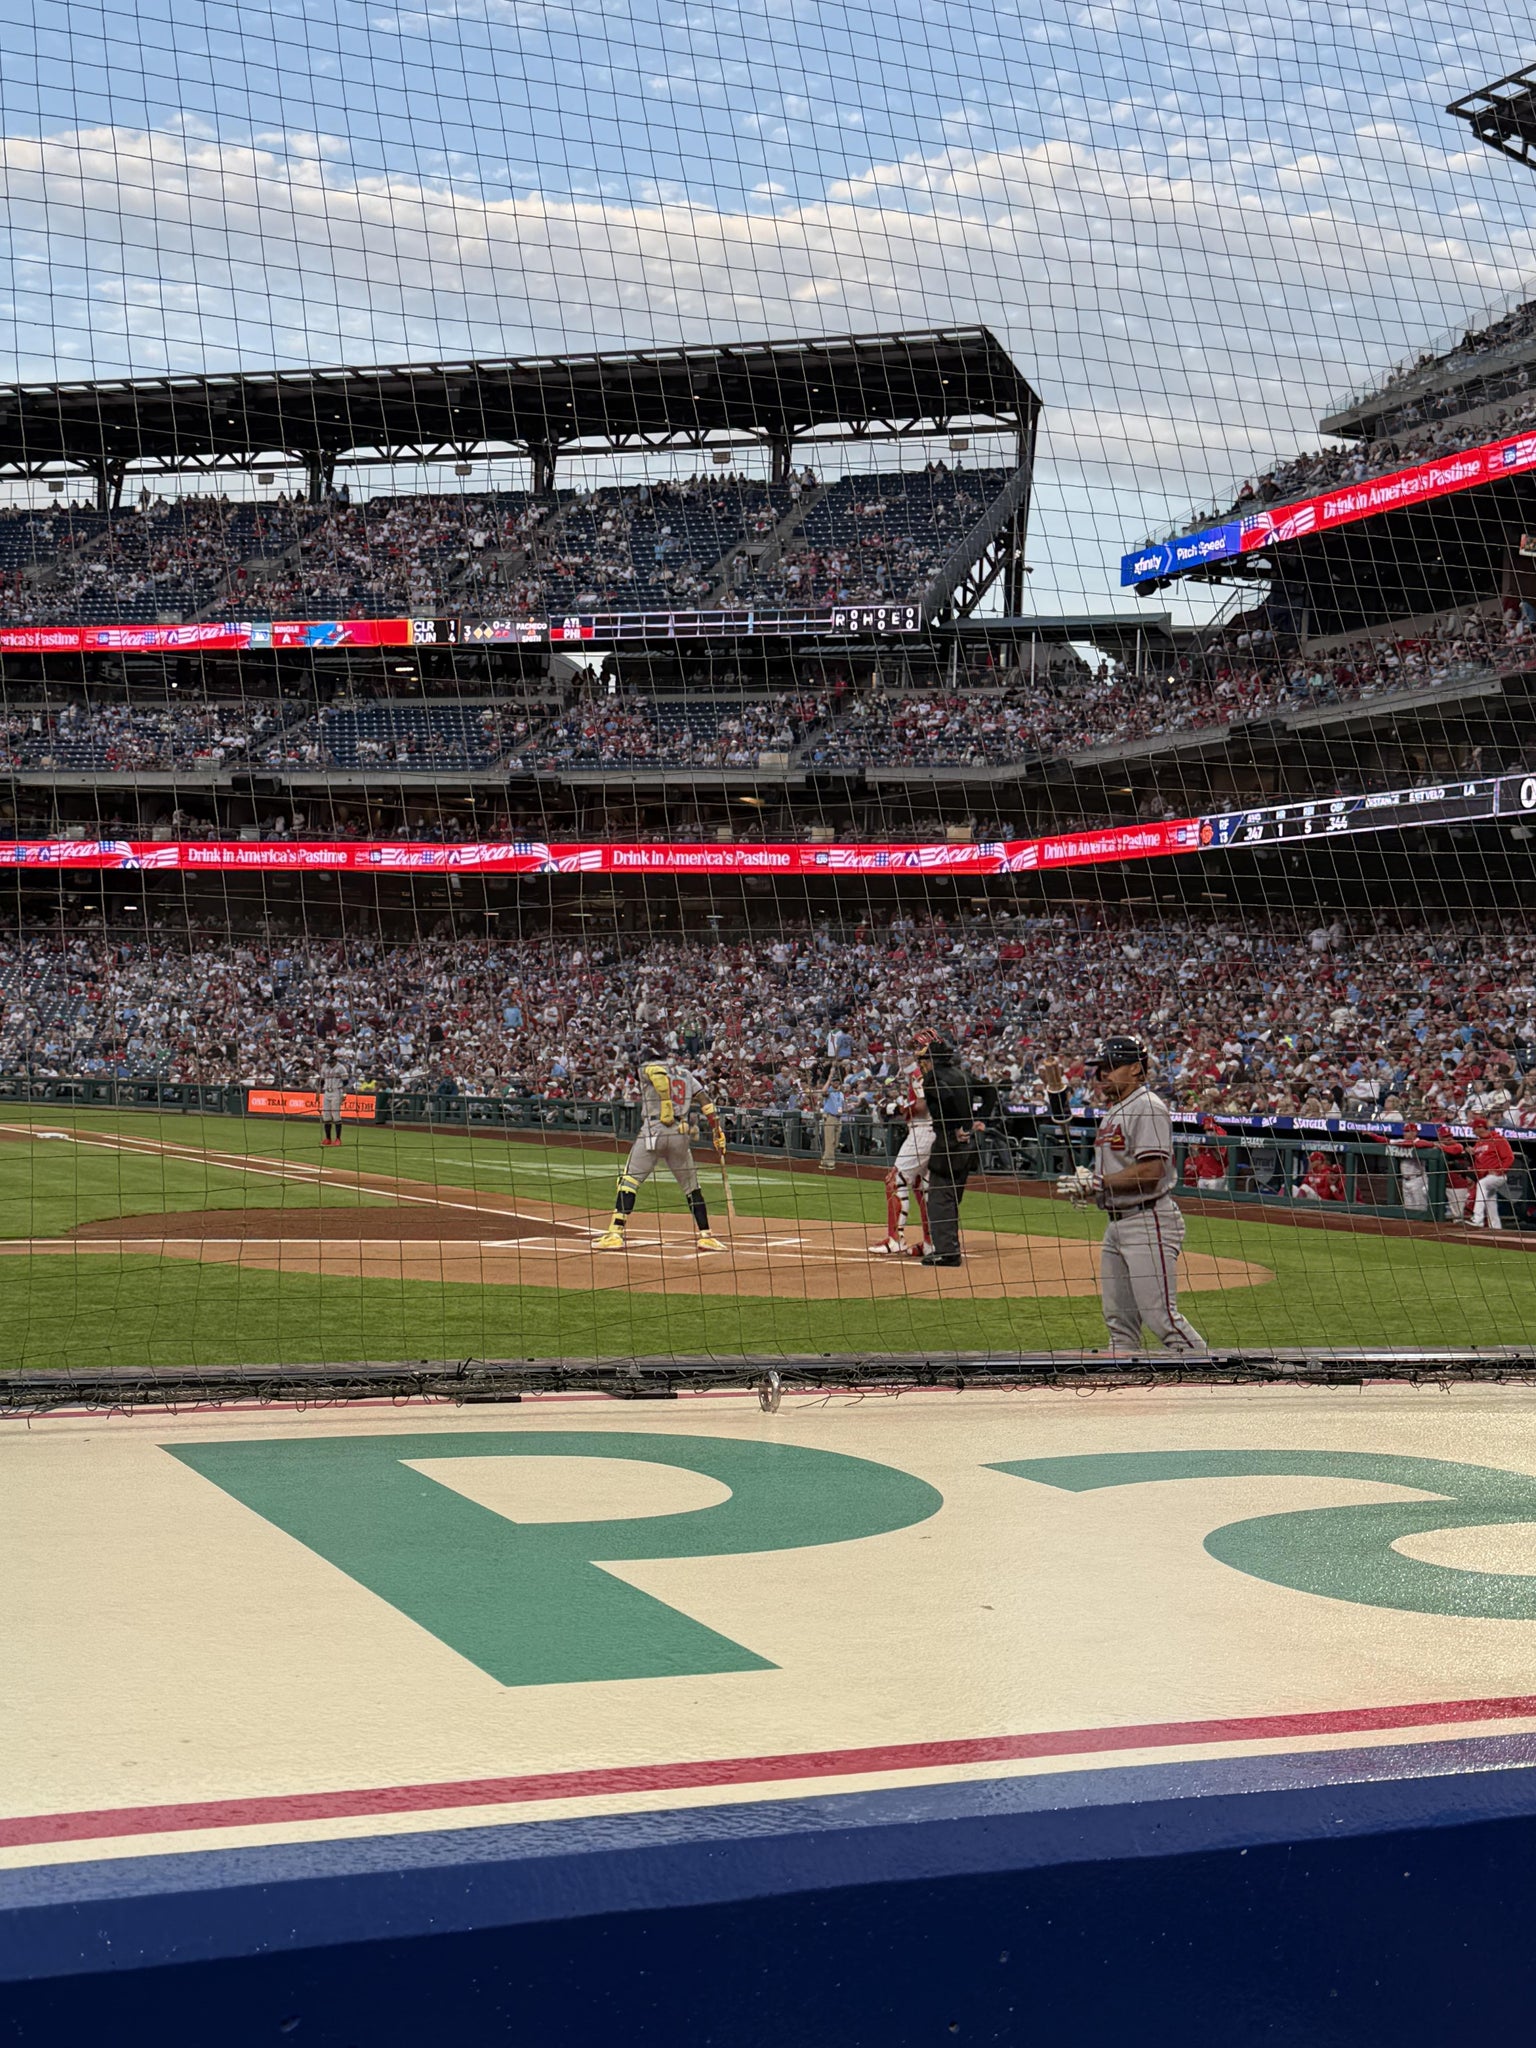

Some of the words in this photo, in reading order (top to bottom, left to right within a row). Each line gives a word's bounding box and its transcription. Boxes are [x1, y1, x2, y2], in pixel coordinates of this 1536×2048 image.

[1324, 497, 1355, 519] Drink
[1356, 493, 1367, 508] in
[1369, 478, 1428, 507] America's
[1430, 460, 1480, 487] Pastime
[1177, 546, 1197, 560] Pitch
[1199, 536, 1226, 556] Speed
[1134, 555, 1162, 575] xfinity
[835, 614, 845, 626] R
[863, 613, 873, 626] H
[891, 612, 900, 625] E
[850, 610, 858, 619] 0
[877, 609, 886, 619] 0
[906, 608, 914, 618] 0
[413, 621, 434, 632] CLR
[449, 621, 455, 630] 1
[492, 621, 511, 629] 0-2
[563, 618, 582, 628] ATL
[850, 621, 858, 631] 0
[877, 621, 885, 630] 0
[906, 620, 914, 630] 0
[274, 625, 299, 633] SINGLE
[463, 626, 471, 637] 3
[564, 629, 580, 639] PHI
[35, 632, 79, 645] Pastime
[282, 634, 291, 643] A
[413, 633, 436, 642] DUN
[448, 632, 456, 642] 4
[1277, 824, 1283, 836] 1
[1304, 820, 1312, 833] 5
[1044, 842, 1067, 860] Drink
[1077, 836, 1123, 855] America's
[1123, 831, 1160, 849] Pastime
[188, 848, 221, 862] Drink
[223, 848, 235, 862] in
[236, 848, 297, 863] America's
[299, 849, 347, 863] Pastime
[613, 850, 648, 865] Drink
[652, 850, 664, 865] in
[666, 851, 733, 866] America's
[736, 850, 790, 865] Pastime
